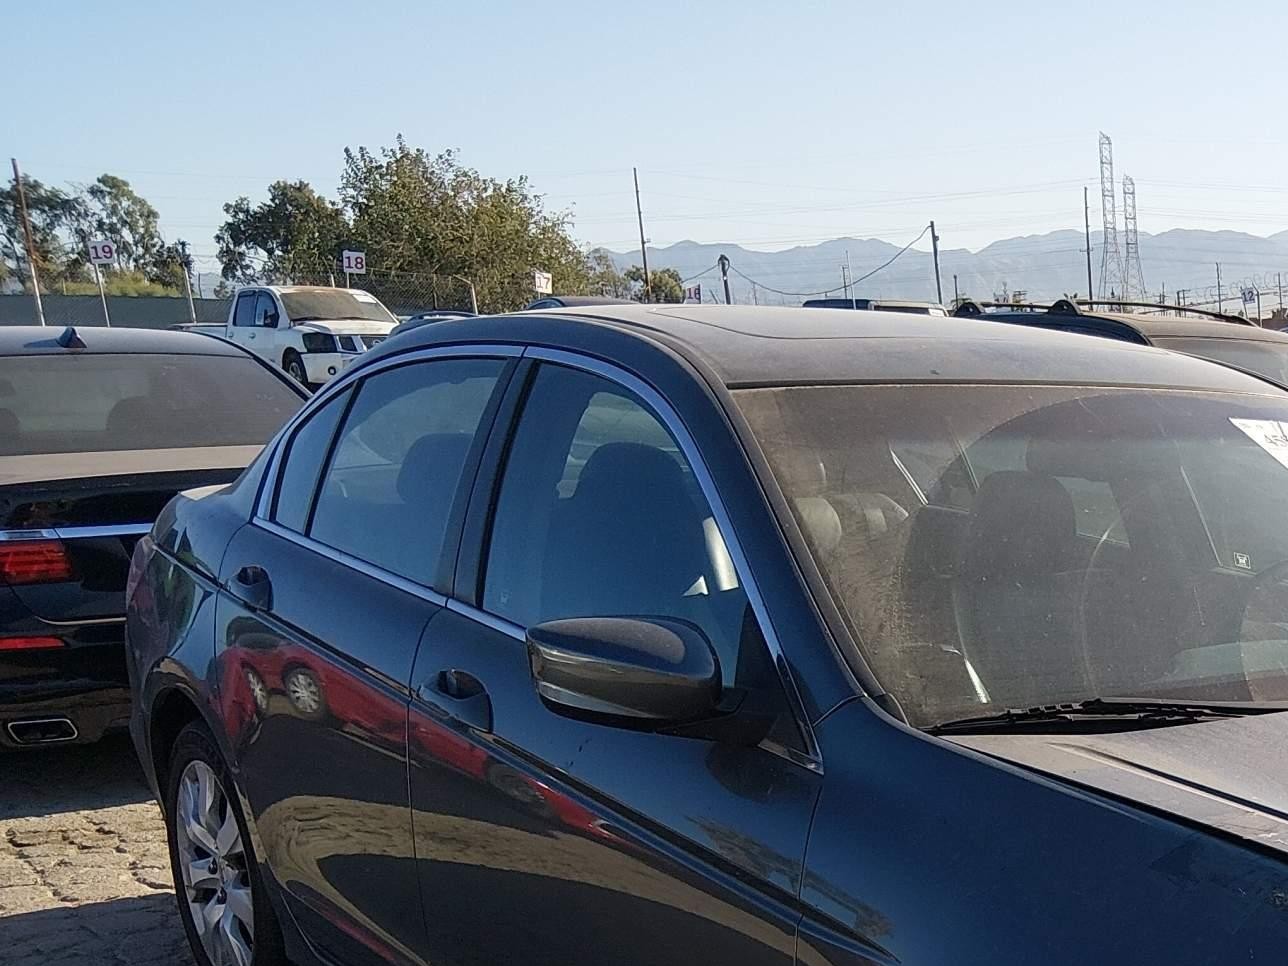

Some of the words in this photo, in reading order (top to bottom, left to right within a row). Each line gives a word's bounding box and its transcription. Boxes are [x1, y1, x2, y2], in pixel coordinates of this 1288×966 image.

[91, 244, 113, 259] 19
[344, 255, 364, 270] 18
[536, 276, 551, 289] 17
[1241, 289, 1255, 303] 12
